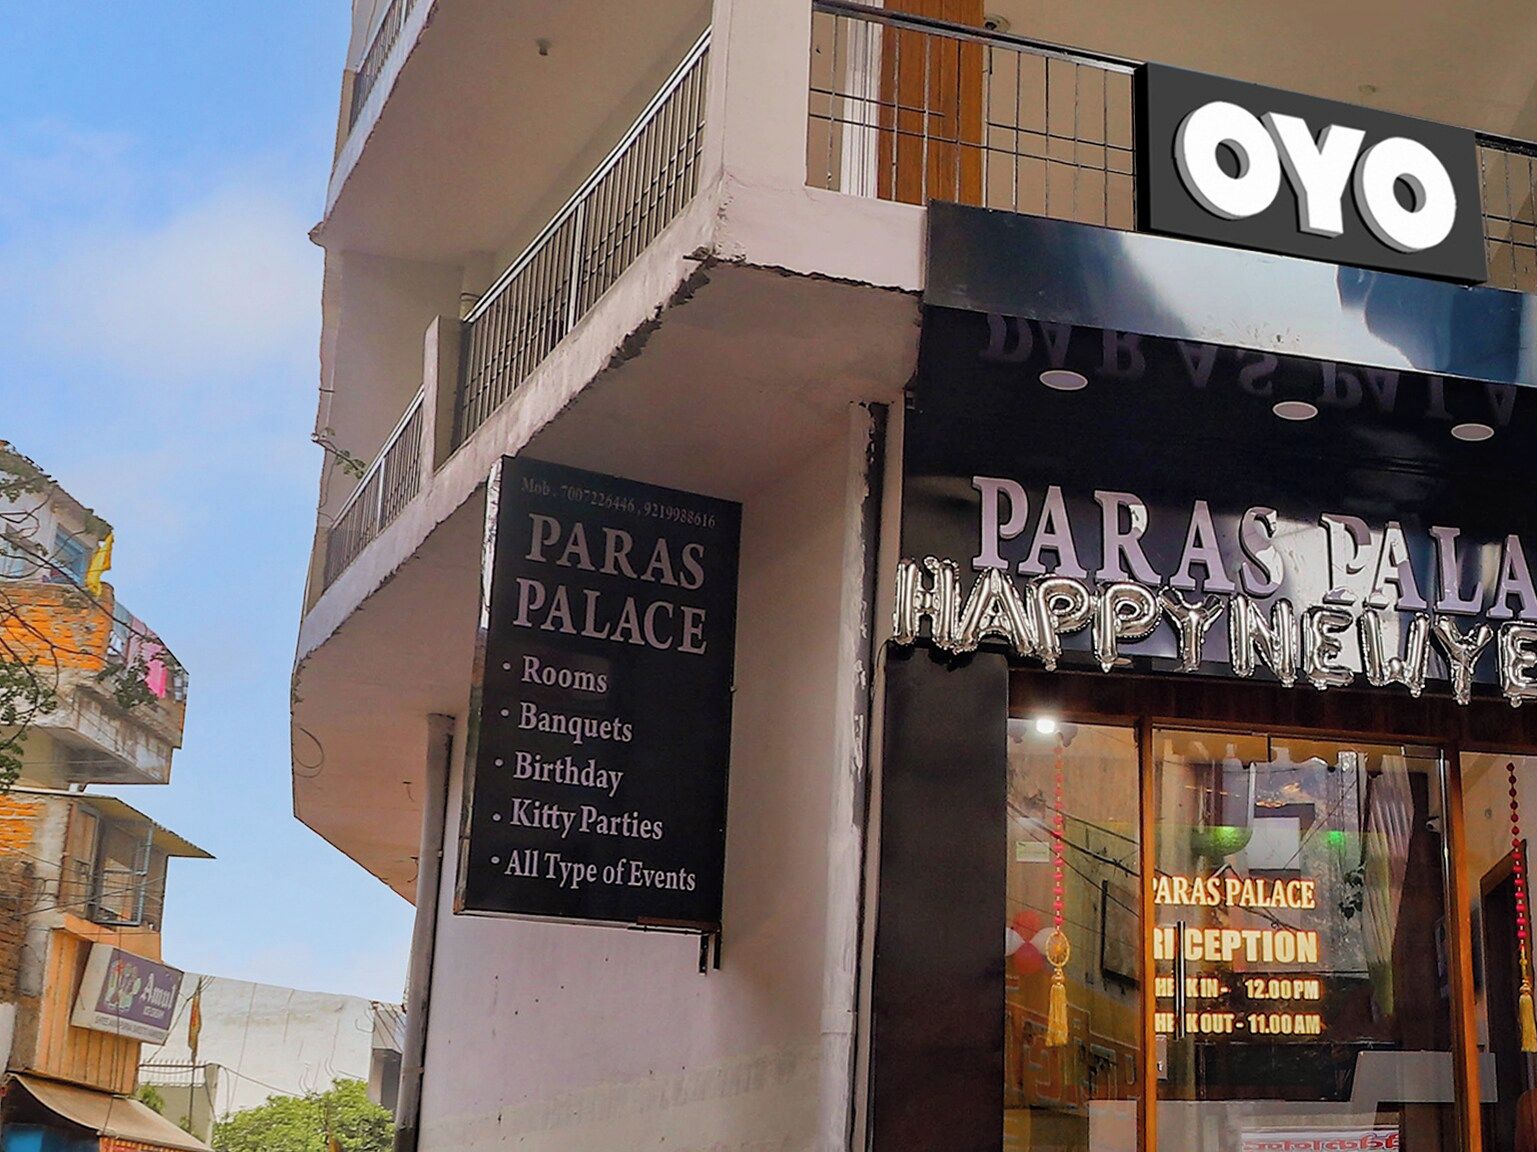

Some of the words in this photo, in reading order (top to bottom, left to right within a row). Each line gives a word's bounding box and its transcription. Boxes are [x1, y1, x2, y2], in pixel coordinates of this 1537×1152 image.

[1174, 100, 1457, 254] OYO
[525, 513, 706, 590] PARAS
[972, 476, 1285, 597] PARAS
[513, 577, 707, 655] PALACE
[894, 556, 1226, 674] HAPPY
[1229, 593, 1430, 698] NEW
[521, 655, 608, 693] Rooms
[518, 702, 632, 744] Banquets
[513, 751, 623, 797] Birthday
[510, 799, 576, 838] Kitty
[579, 805, 663, 840] Parties
[504, 850, 538, 877] All
[544, 853, 597, 889] Type
[603, 858, 626, 884] of
[628, 861, 696, 891] Events
[1153, 876, 1221, 906] ARAS
[1225, 878, 1316, 909] PALACE
[140, 972, 176, 1010] Amul
[1154, 977, 1199, 997] HEK
[1293, 979, 1320, 1000] PM
[1154, 1012, 1199, 1033] HEK
[1200, 1013, 1235, 1034] OUT
[1293, 1014, 1322, 1035] AM
